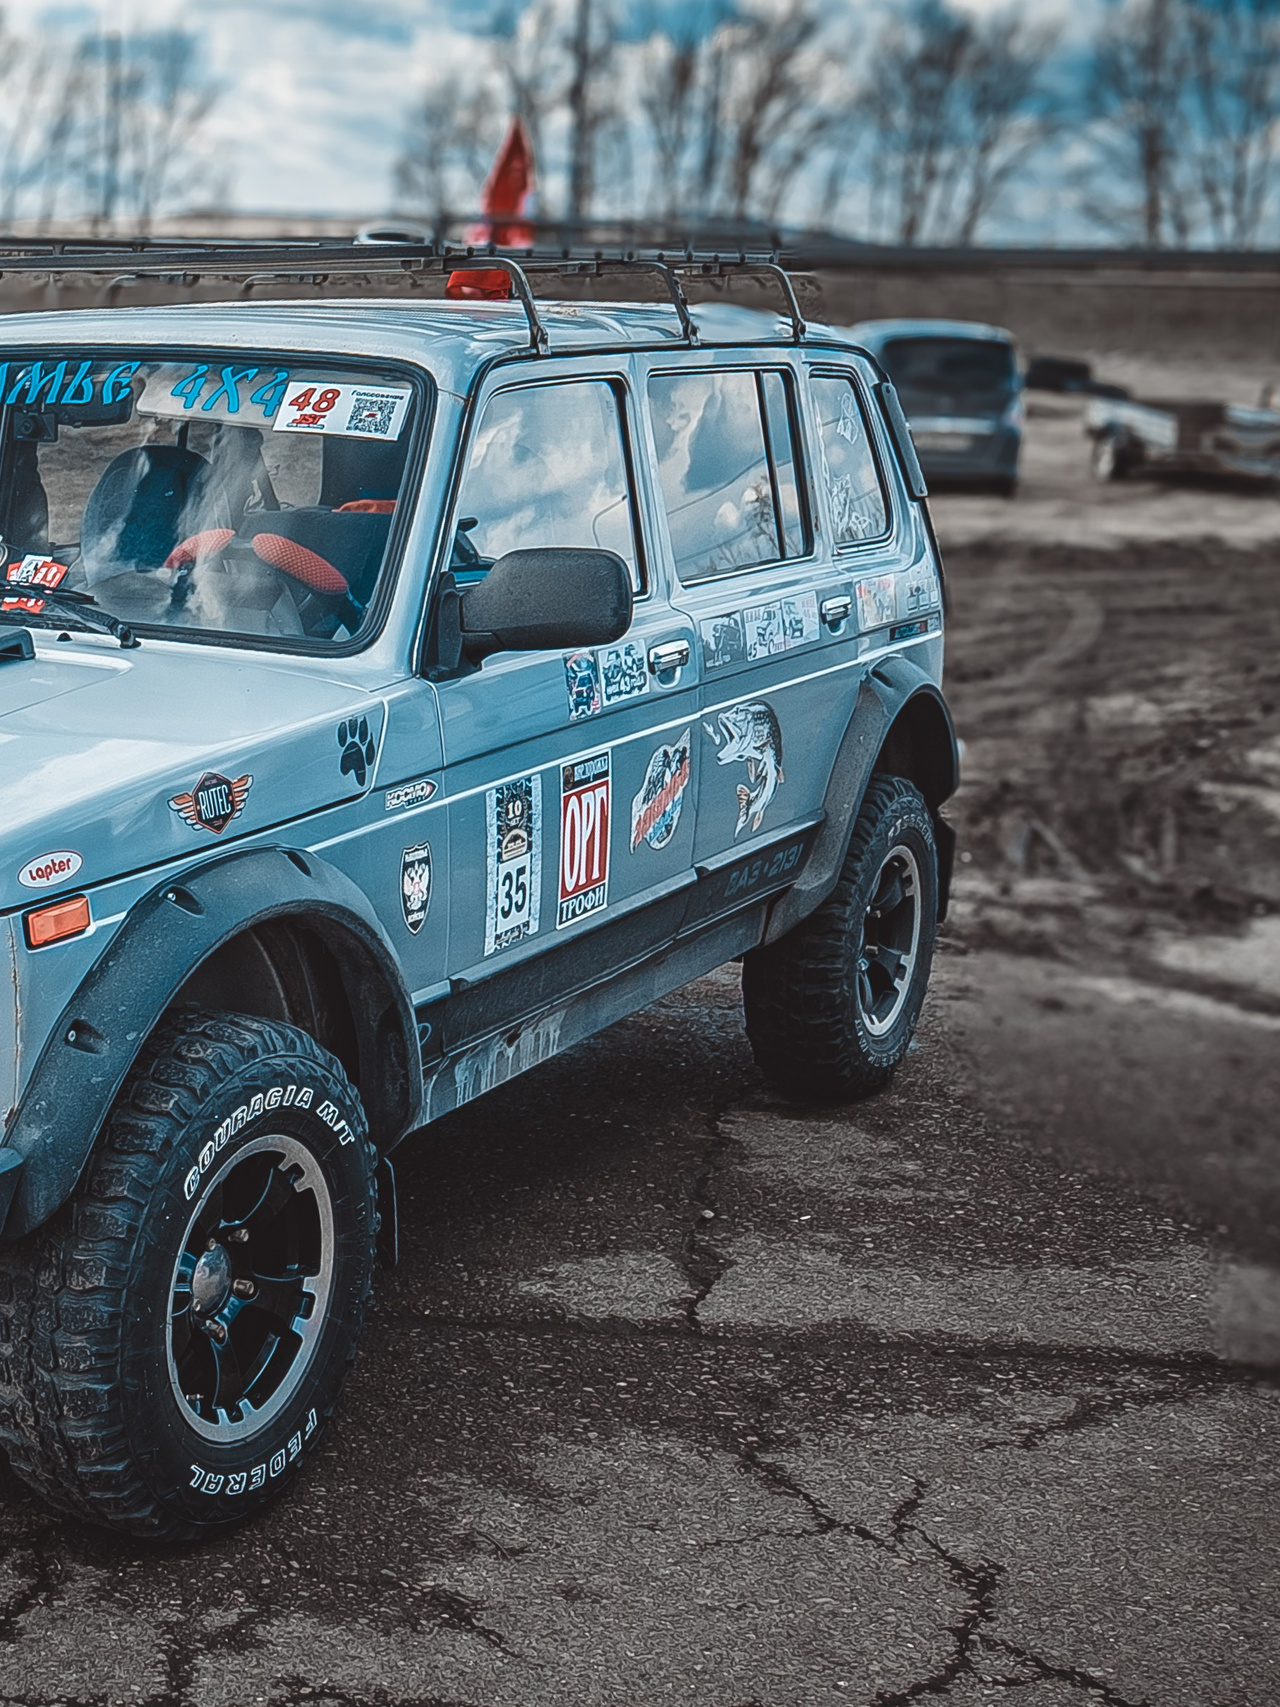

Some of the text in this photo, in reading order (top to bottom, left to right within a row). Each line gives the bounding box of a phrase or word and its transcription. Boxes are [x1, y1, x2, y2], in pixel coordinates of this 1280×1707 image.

[288, 387, 341, 413] 48
[198, 784, 232, 820] RUTEC
[507, 800, 522, 819] 10
[564, 785, 608, 892] ОРГ
[500, 864, 527, 919] 35
[561, 885, 605, 922] ТРОФИ
[189, 1407, 318, 1496] FEDERAL
